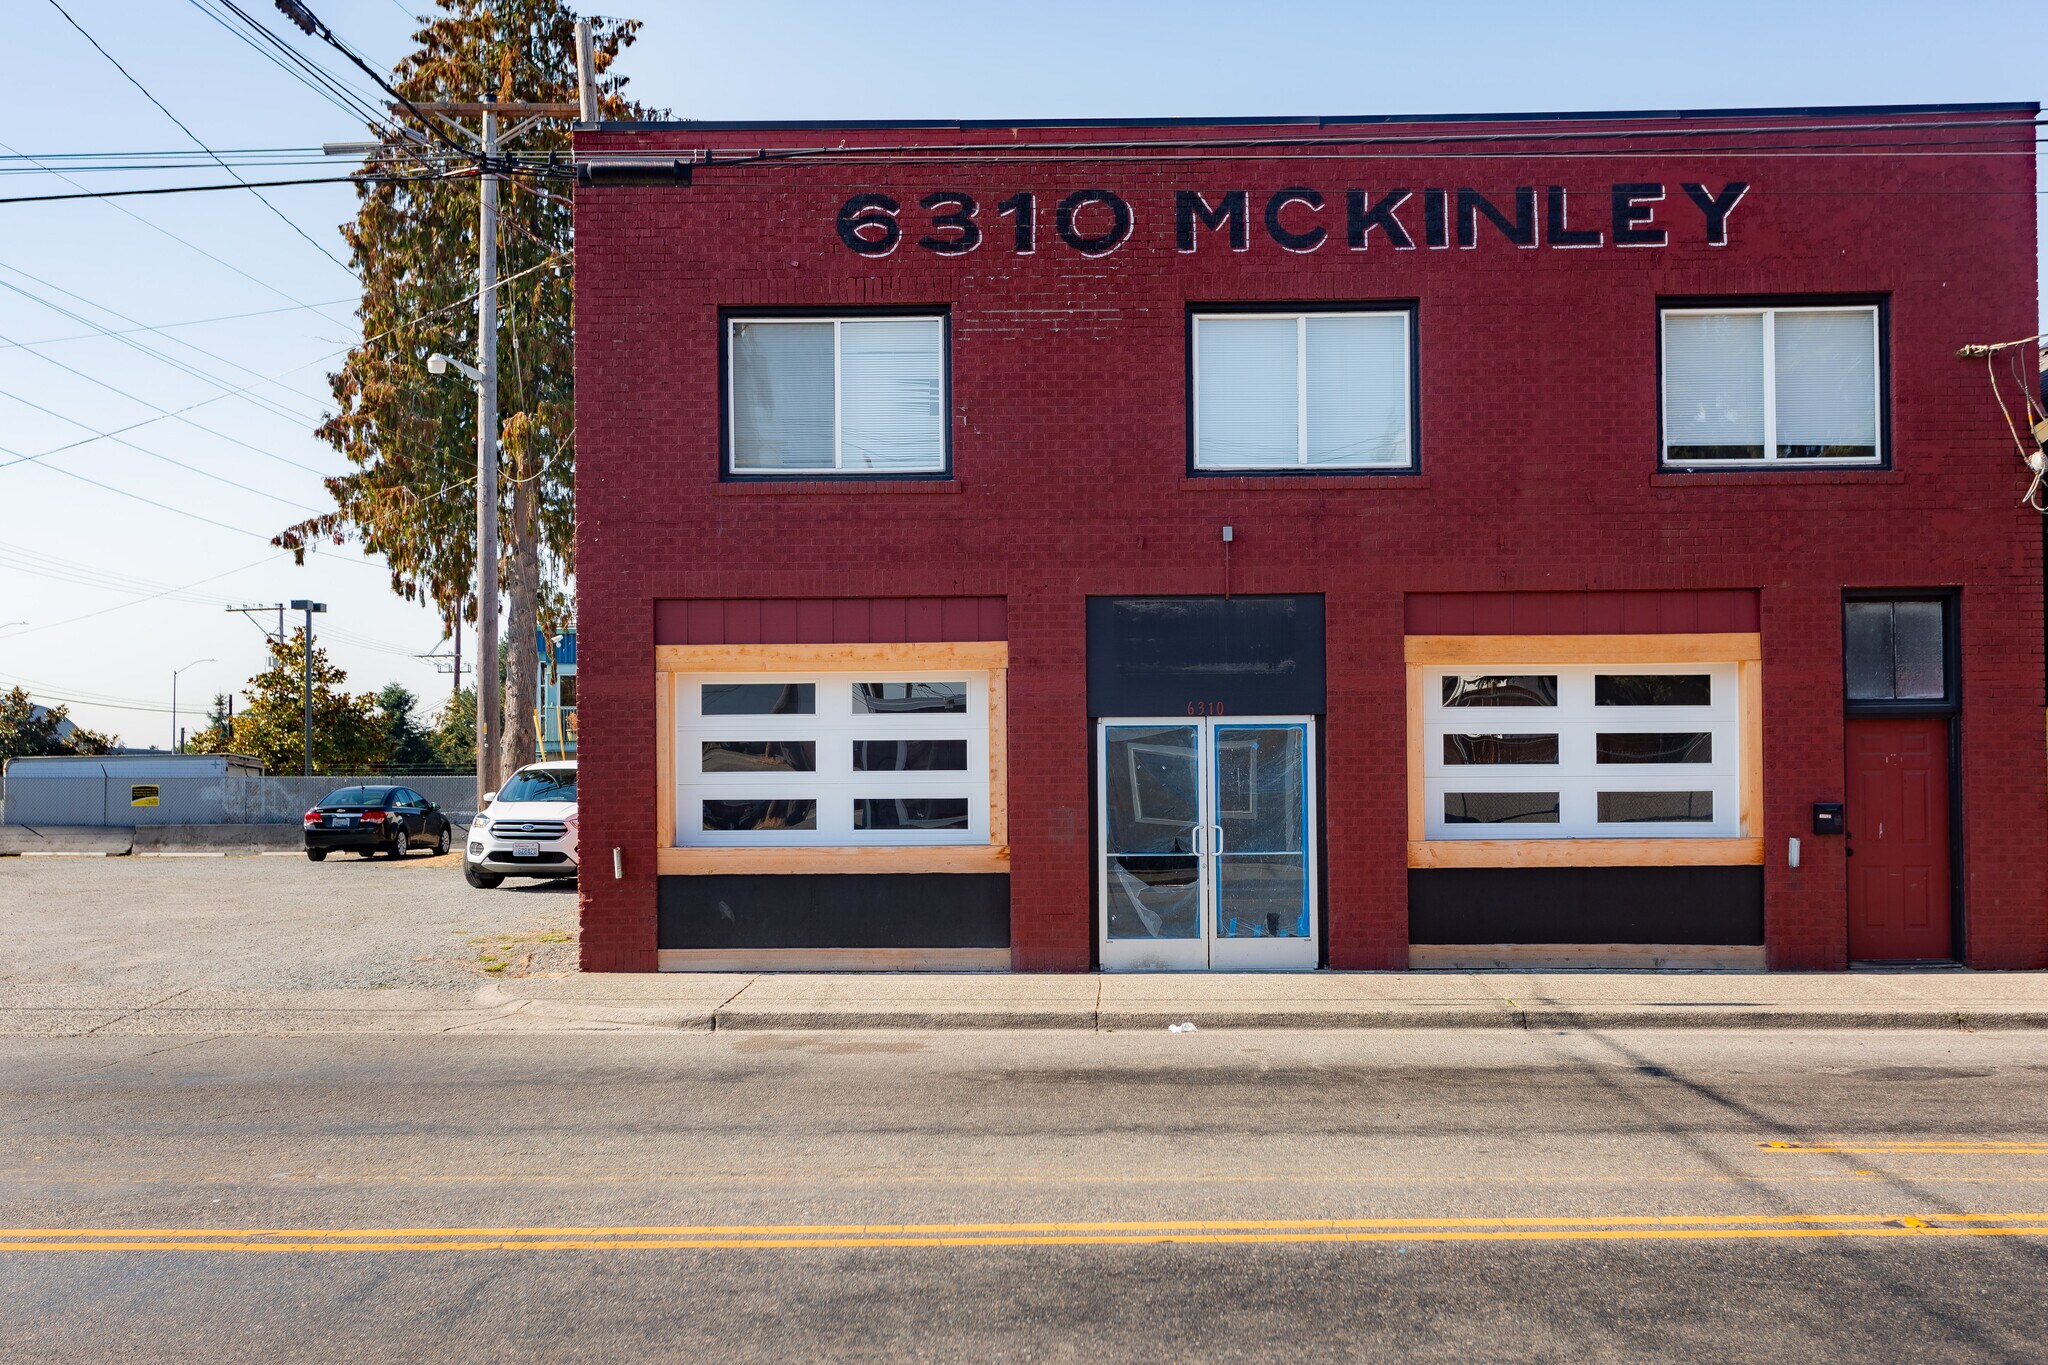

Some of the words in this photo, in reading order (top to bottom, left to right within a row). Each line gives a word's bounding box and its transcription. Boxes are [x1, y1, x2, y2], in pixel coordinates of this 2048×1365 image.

[837, 189, 1135, 258] 6310
[1175, 182, 1751, 254] MCKINLEY
[1187, 700, 1224, 716] 6310
